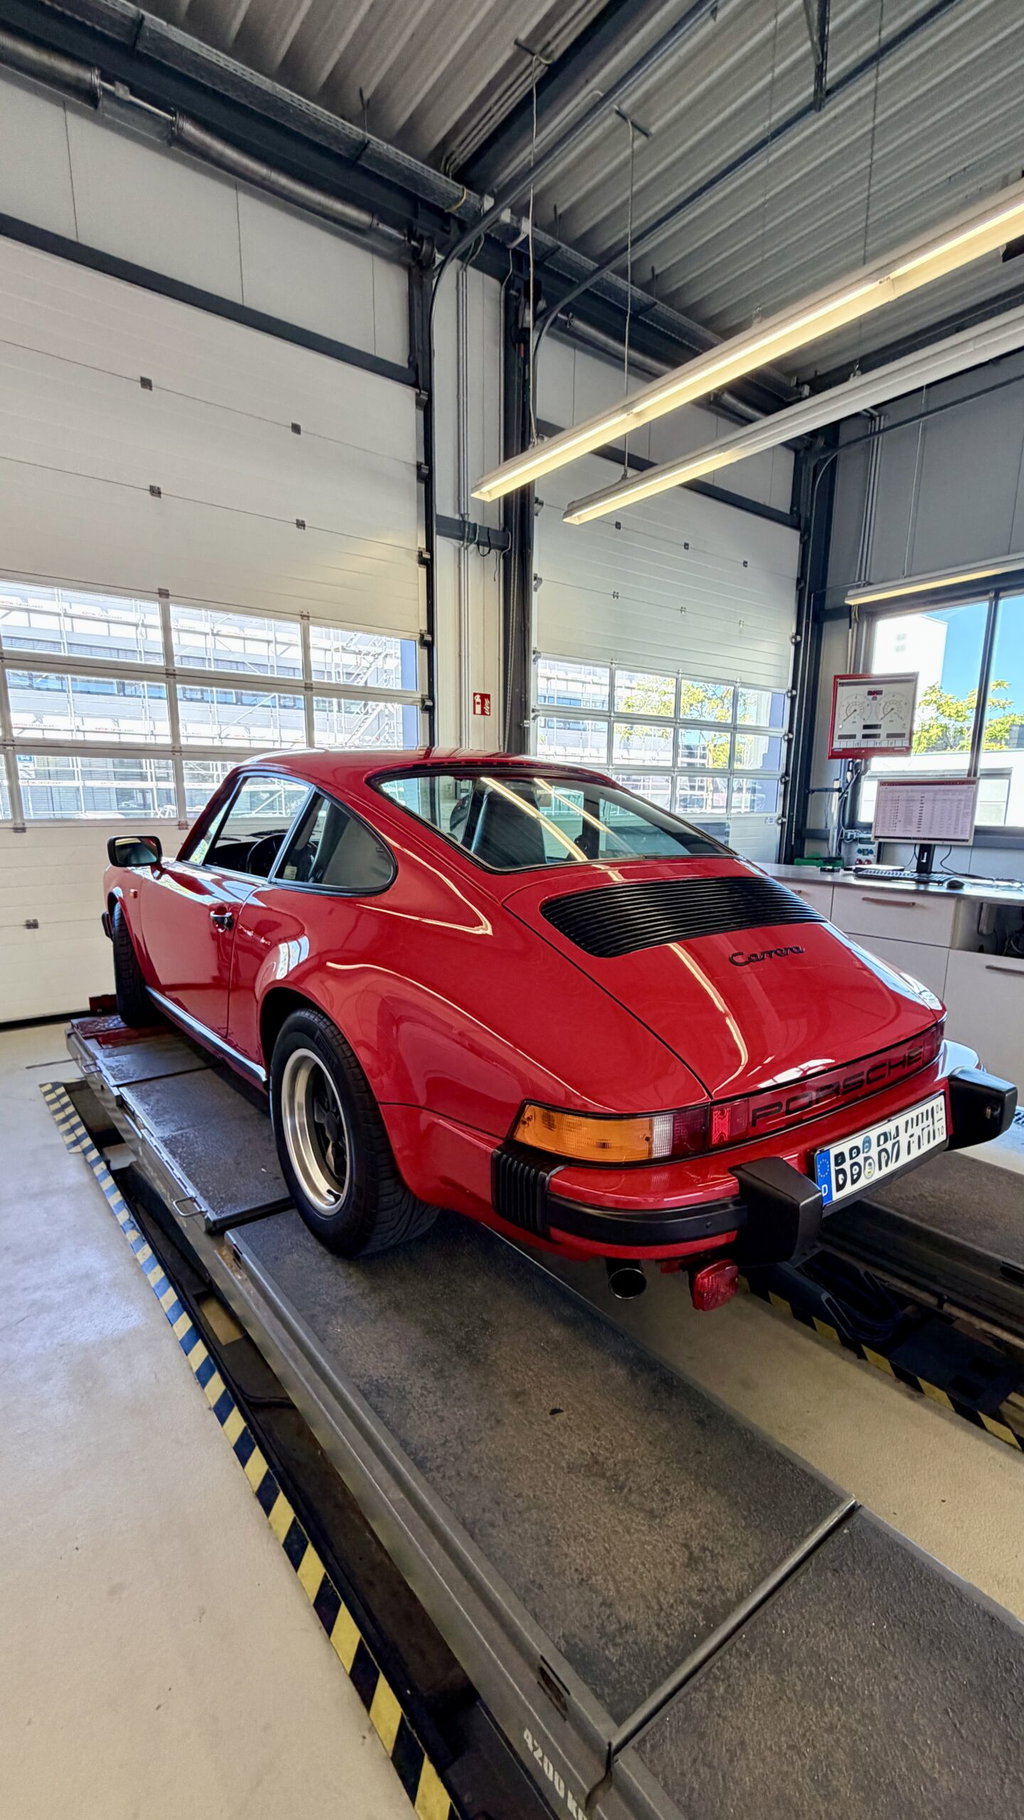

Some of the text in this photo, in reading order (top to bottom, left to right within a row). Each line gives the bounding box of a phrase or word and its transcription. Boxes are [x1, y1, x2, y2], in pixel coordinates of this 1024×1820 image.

[729, 945, 805, 967] Carrera
[751, 1046, 923, 1128] PORSCHE
[821, 1184, 829, 1197] D
[523, 1727, 565, 1799] 4200
